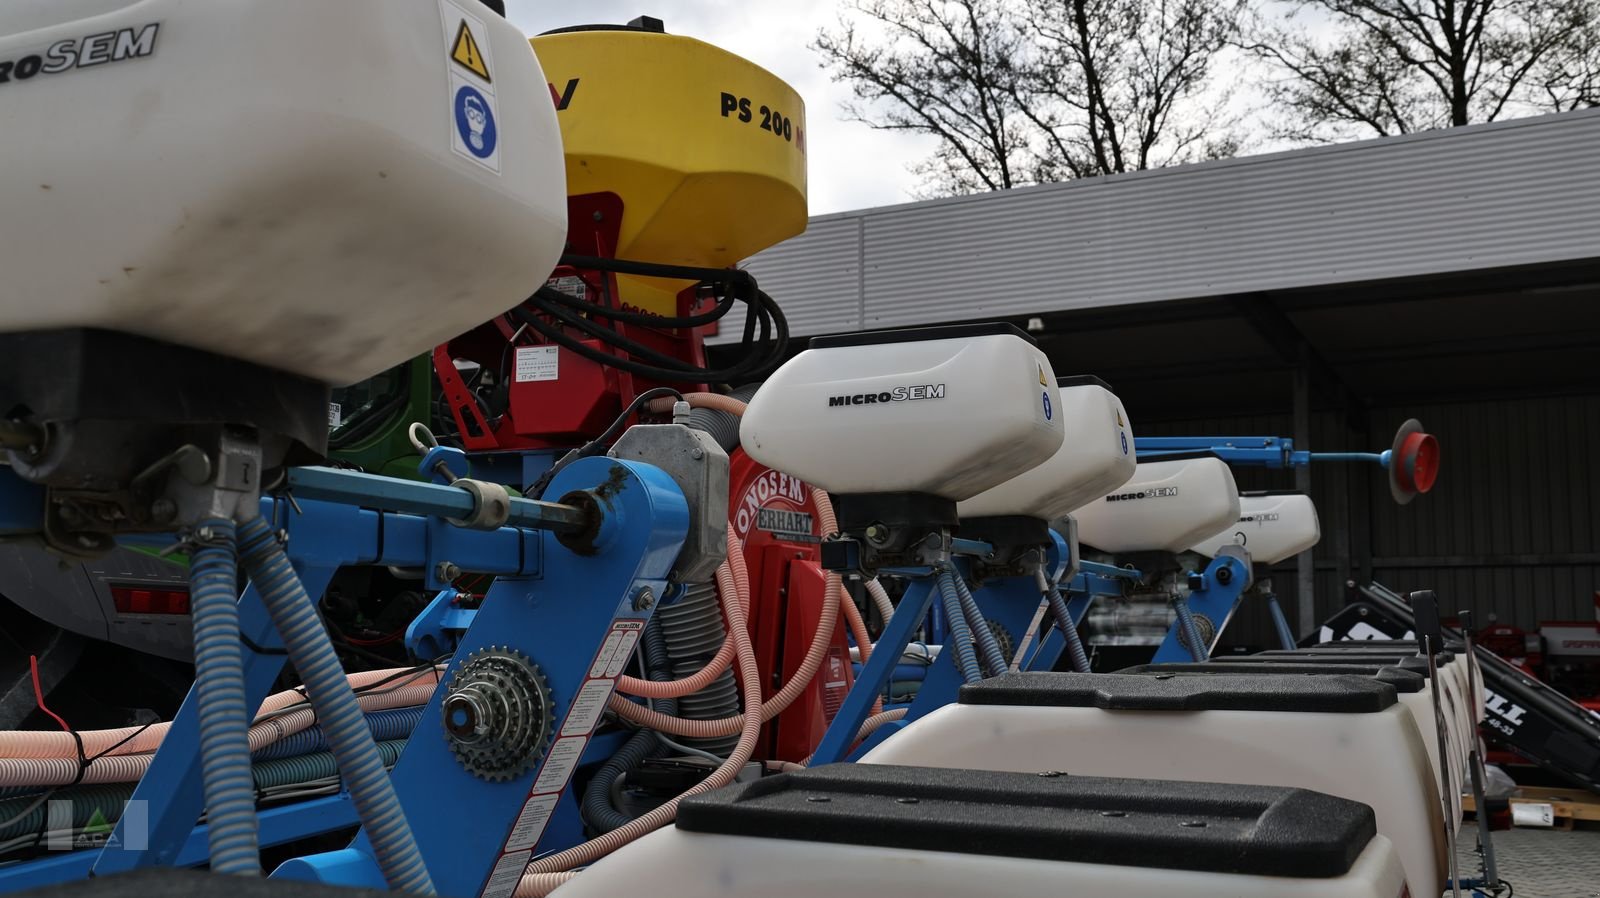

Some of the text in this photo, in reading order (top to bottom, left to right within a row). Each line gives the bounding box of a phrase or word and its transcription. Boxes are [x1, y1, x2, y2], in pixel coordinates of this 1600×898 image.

[720, 91, 752, 123] PS
[759, 105, 792, 142] 200
[829, 384, 945, 407] MICROSEM
[1106, 487, 1178, 502] MICROSEM
[738, 472, 803, 548] ONOSEM
[758, 509, 811, 533] ERHART
